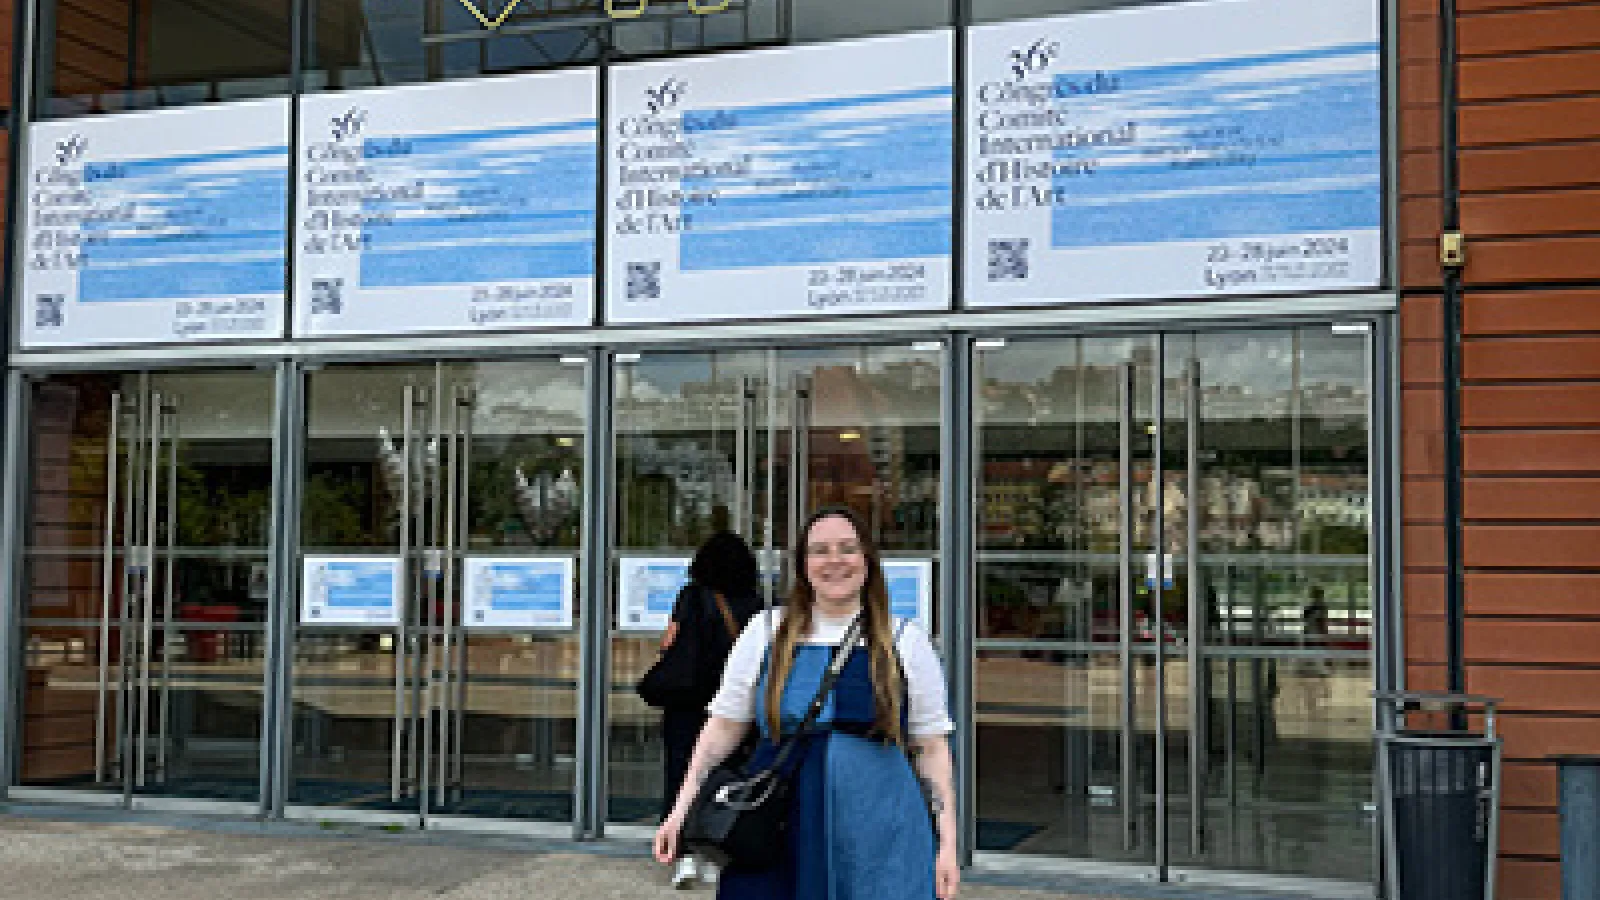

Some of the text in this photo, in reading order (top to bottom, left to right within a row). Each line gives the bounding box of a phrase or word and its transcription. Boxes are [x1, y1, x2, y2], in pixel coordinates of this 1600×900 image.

[979, 121, 1137, 155] International
[1303, 237, 1348, 258] 2024
[1204, 268, 1257, 290] Lyon
